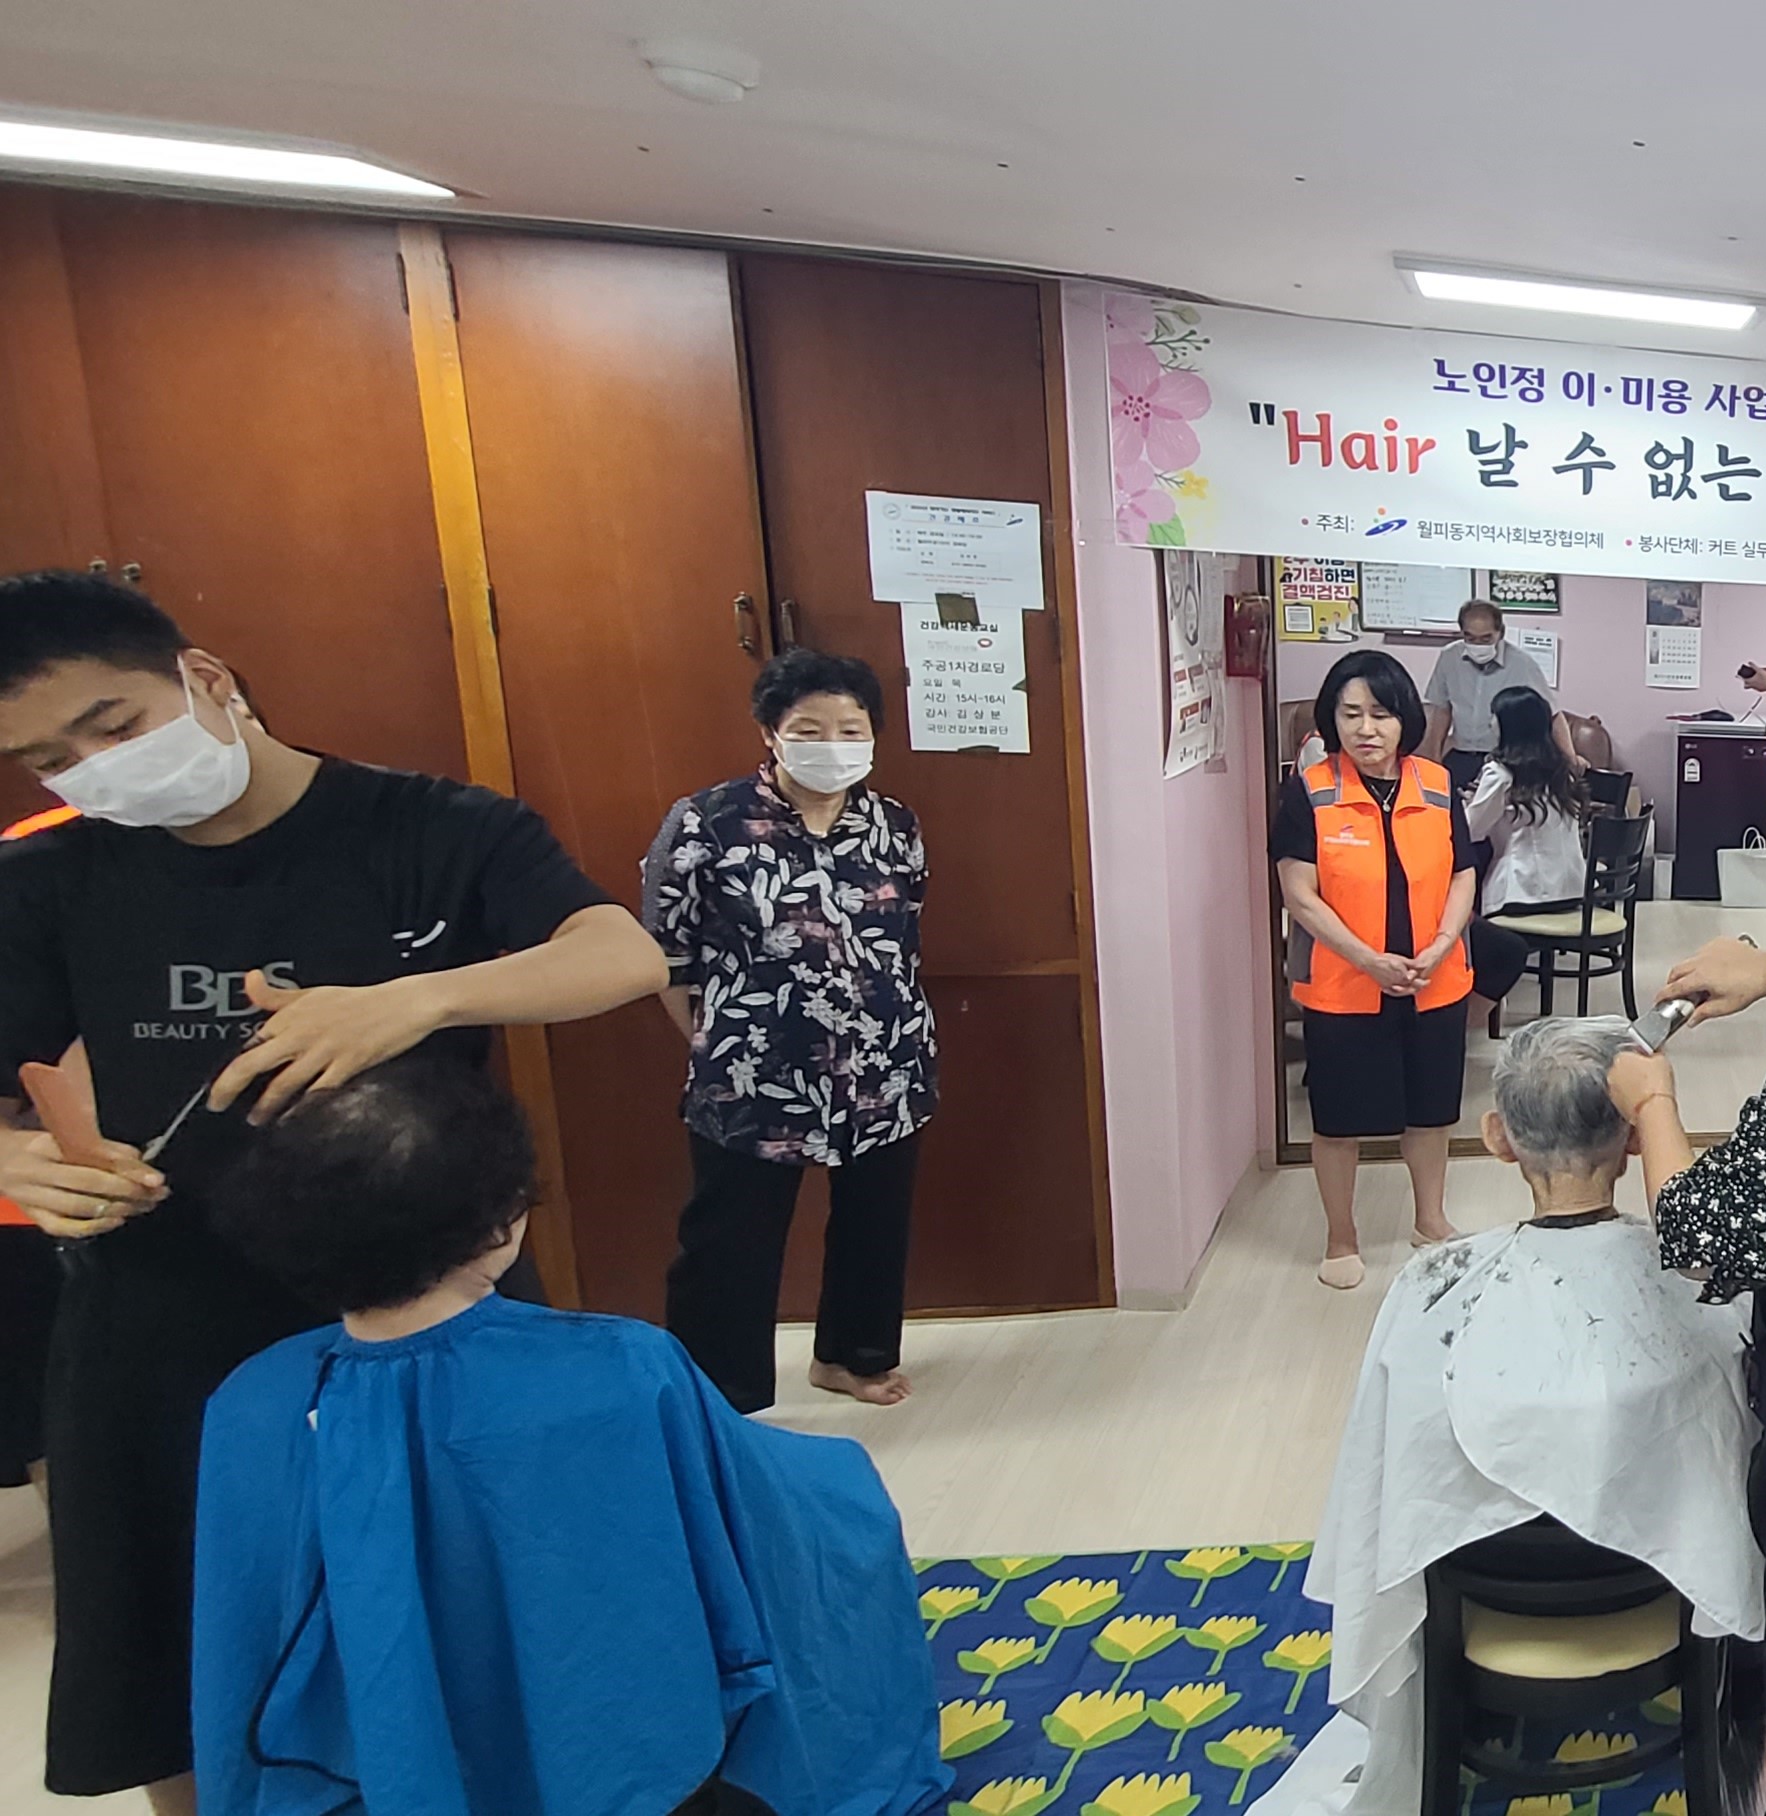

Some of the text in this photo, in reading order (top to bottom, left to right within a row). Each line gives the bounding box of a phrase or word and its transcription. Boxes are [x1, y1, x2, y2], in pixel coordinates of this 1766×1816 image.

[1433, 358, 1546, 403] 노인정
[1562, 371, 1693, 415] 이·미용
[1466, 422, 1529, 488] 날
[1552, 430, 1617, 496] 수
[1644, 435, 1763, 502] 없는
[1315, 513, 1605, 550] 주최: 월피동지역사회보장협의체
[1638, 534, 1704, 555] 봉사단체:
[1708, 538, 1738, 557] 커트
[1292, 567, 1356, 584] 기침하면
[1282, 584, 1352, 601] 결핵검진
[133, 1022, 232, 1040] BEAUTY
